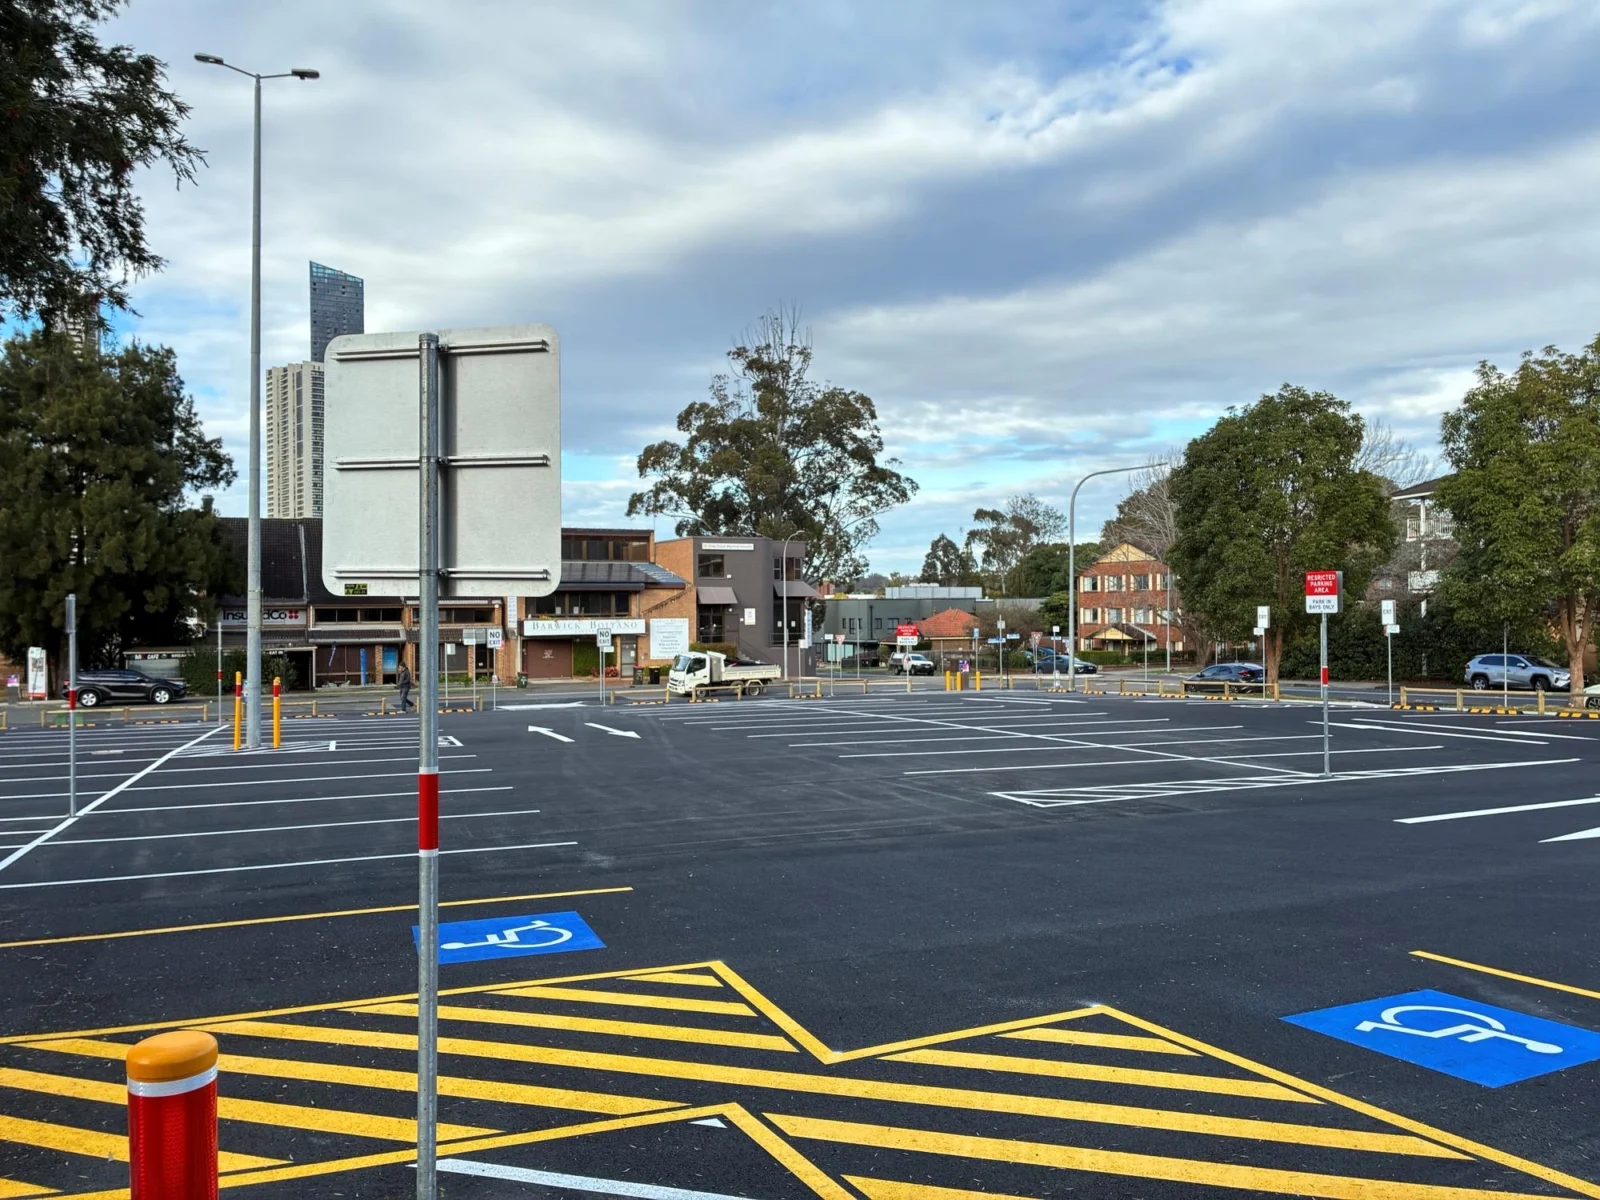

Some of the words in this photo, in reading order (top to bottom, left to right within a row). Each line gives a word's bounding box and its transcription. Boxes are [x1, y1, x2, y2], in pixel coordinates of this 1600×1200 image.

[222, 609, 287, 620] InsudCo
[532, 621, 581, 630] BARWICK
[599, 630, 610, 638] NO
